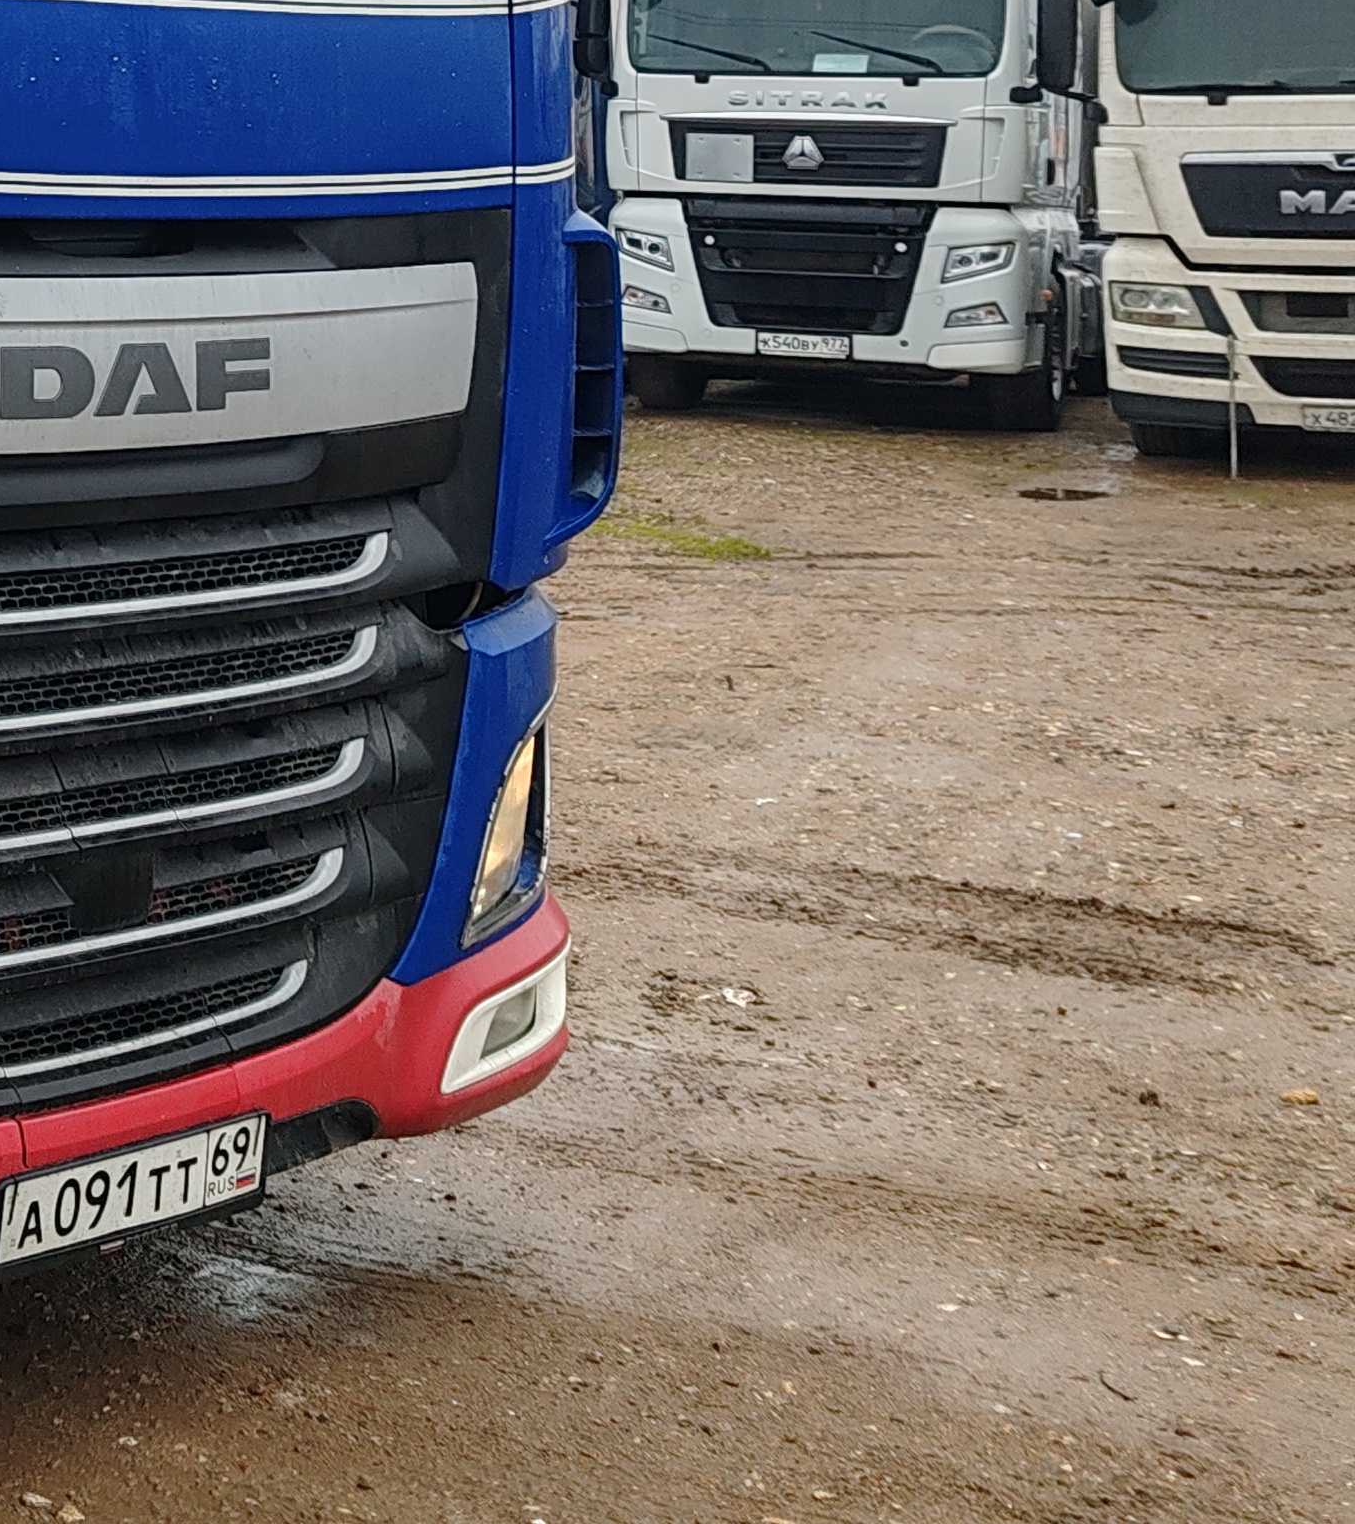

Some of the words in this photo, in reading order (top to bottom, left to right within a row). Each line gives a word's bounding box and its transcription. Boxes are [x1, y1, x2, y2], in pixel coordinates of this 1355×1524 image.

[727, 89, 888, 110] SITRAK
[210, 1125, 251, 1177] 69
[207, 1171, 236, 1198] RUS
